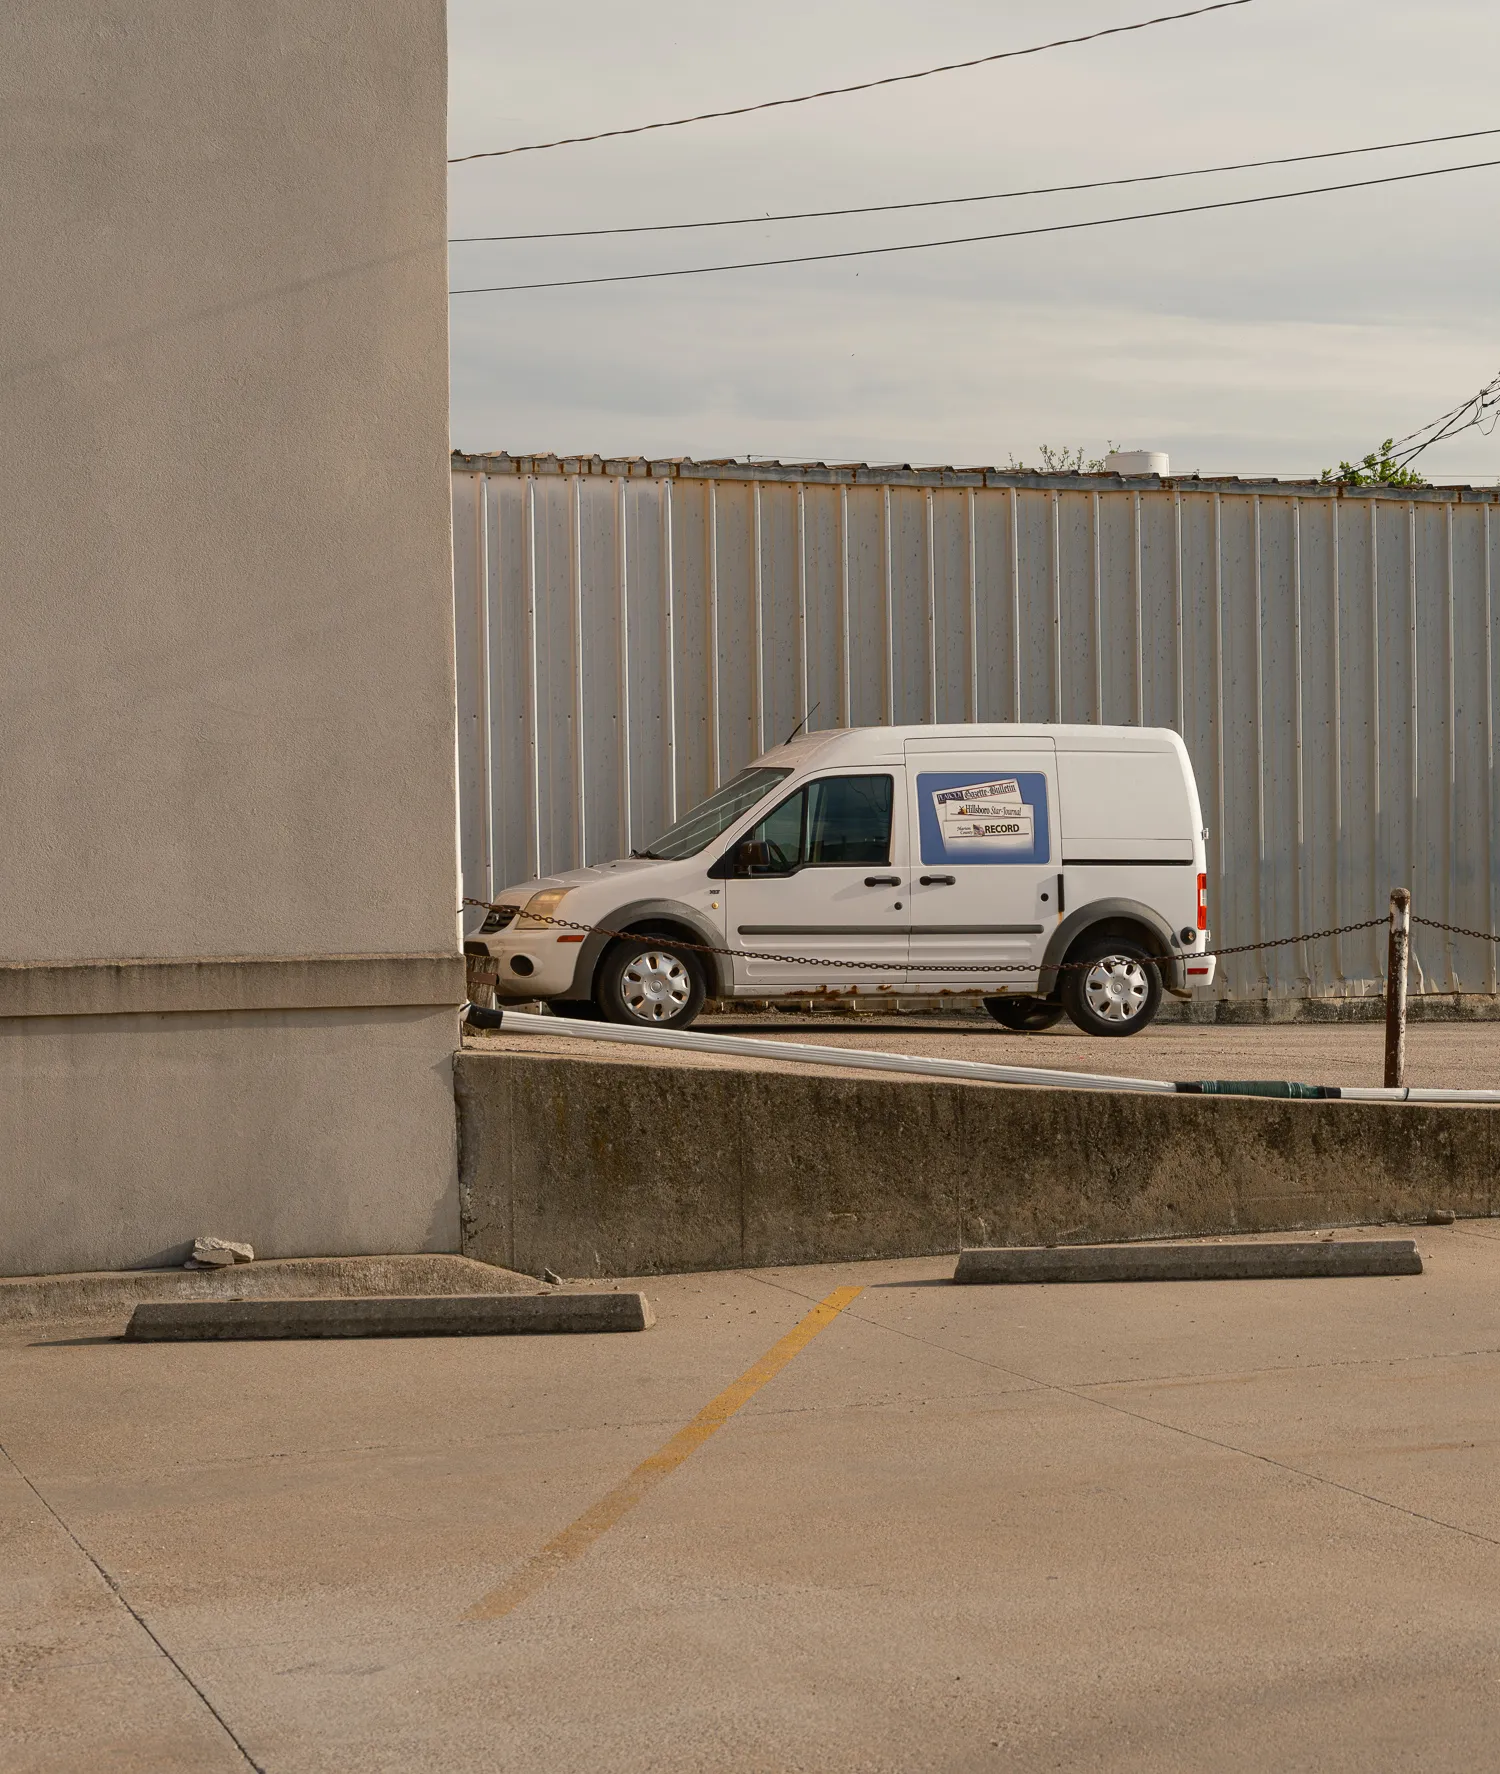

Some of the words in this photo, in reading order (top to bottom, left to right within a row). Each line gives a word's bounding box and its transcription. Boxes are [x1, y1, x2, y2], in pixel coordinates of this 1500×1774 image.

[965, 804, 990, 814] Hillsboro
[990, 806, 1021, 816] Star-Journal
[984, 824, 1019, 833] RECORD
